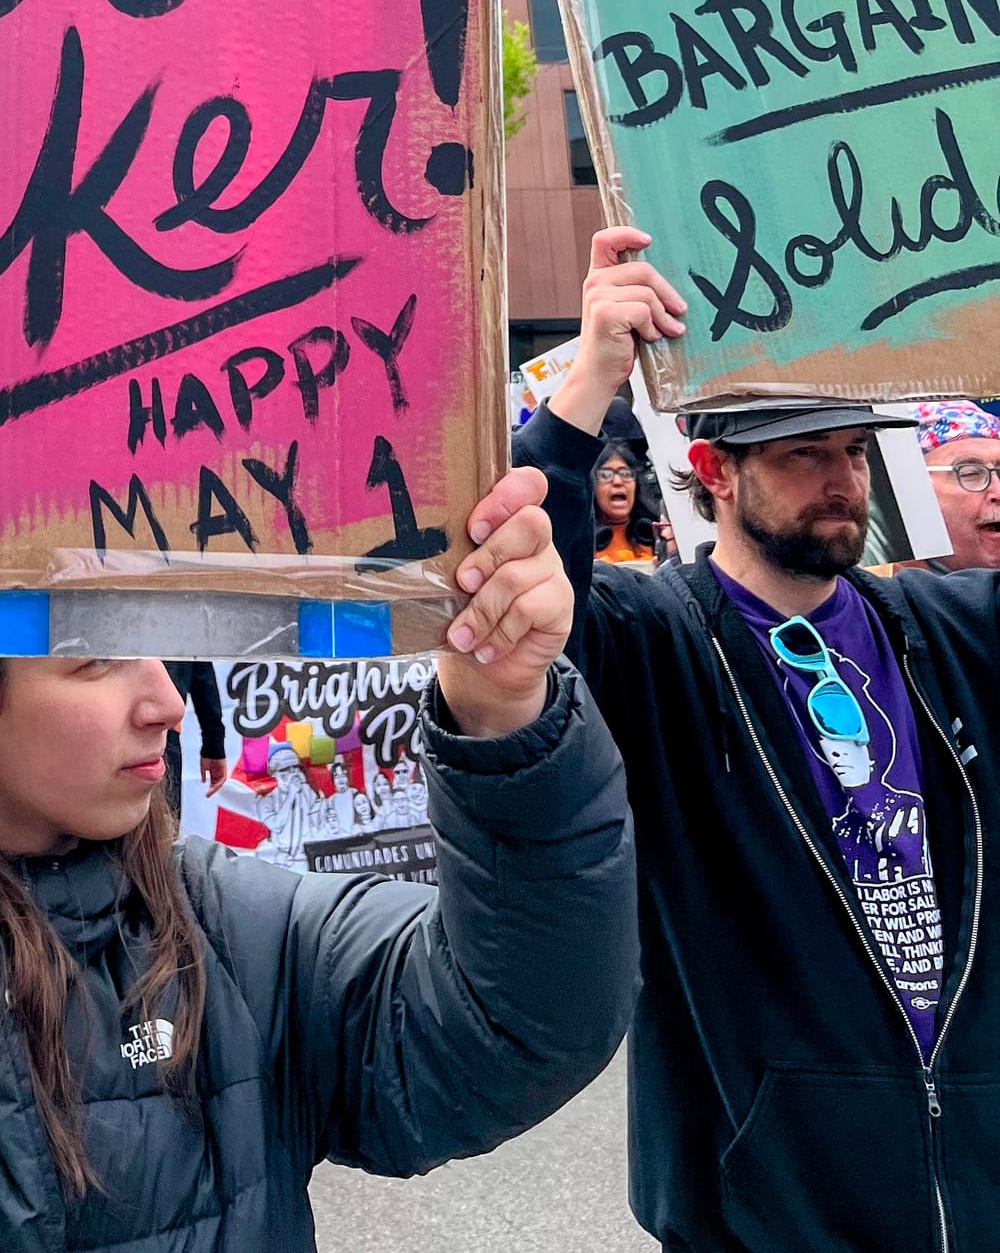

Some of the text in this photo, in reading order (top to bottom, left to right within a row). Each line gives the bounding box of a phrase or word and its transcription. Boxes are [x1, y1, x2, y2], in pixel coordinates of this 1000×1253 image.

[127, 293, 417, 457] HAPPY
[89, 434, 450, 574] MAY 1
[231, 661, 435, 729] Brighto
[864, 885, 908, 902] LABOR
[907, 881, 921, 896] IS
[880, 901, 909, 916] FOR
[883, 914, 917, 930] WILL
[896, 928, 925, 945] AND
[902, 958, 932, 974] AND
[894, 977, 939, 991] arsons
[130, 1045, 166, 1069] FACE
